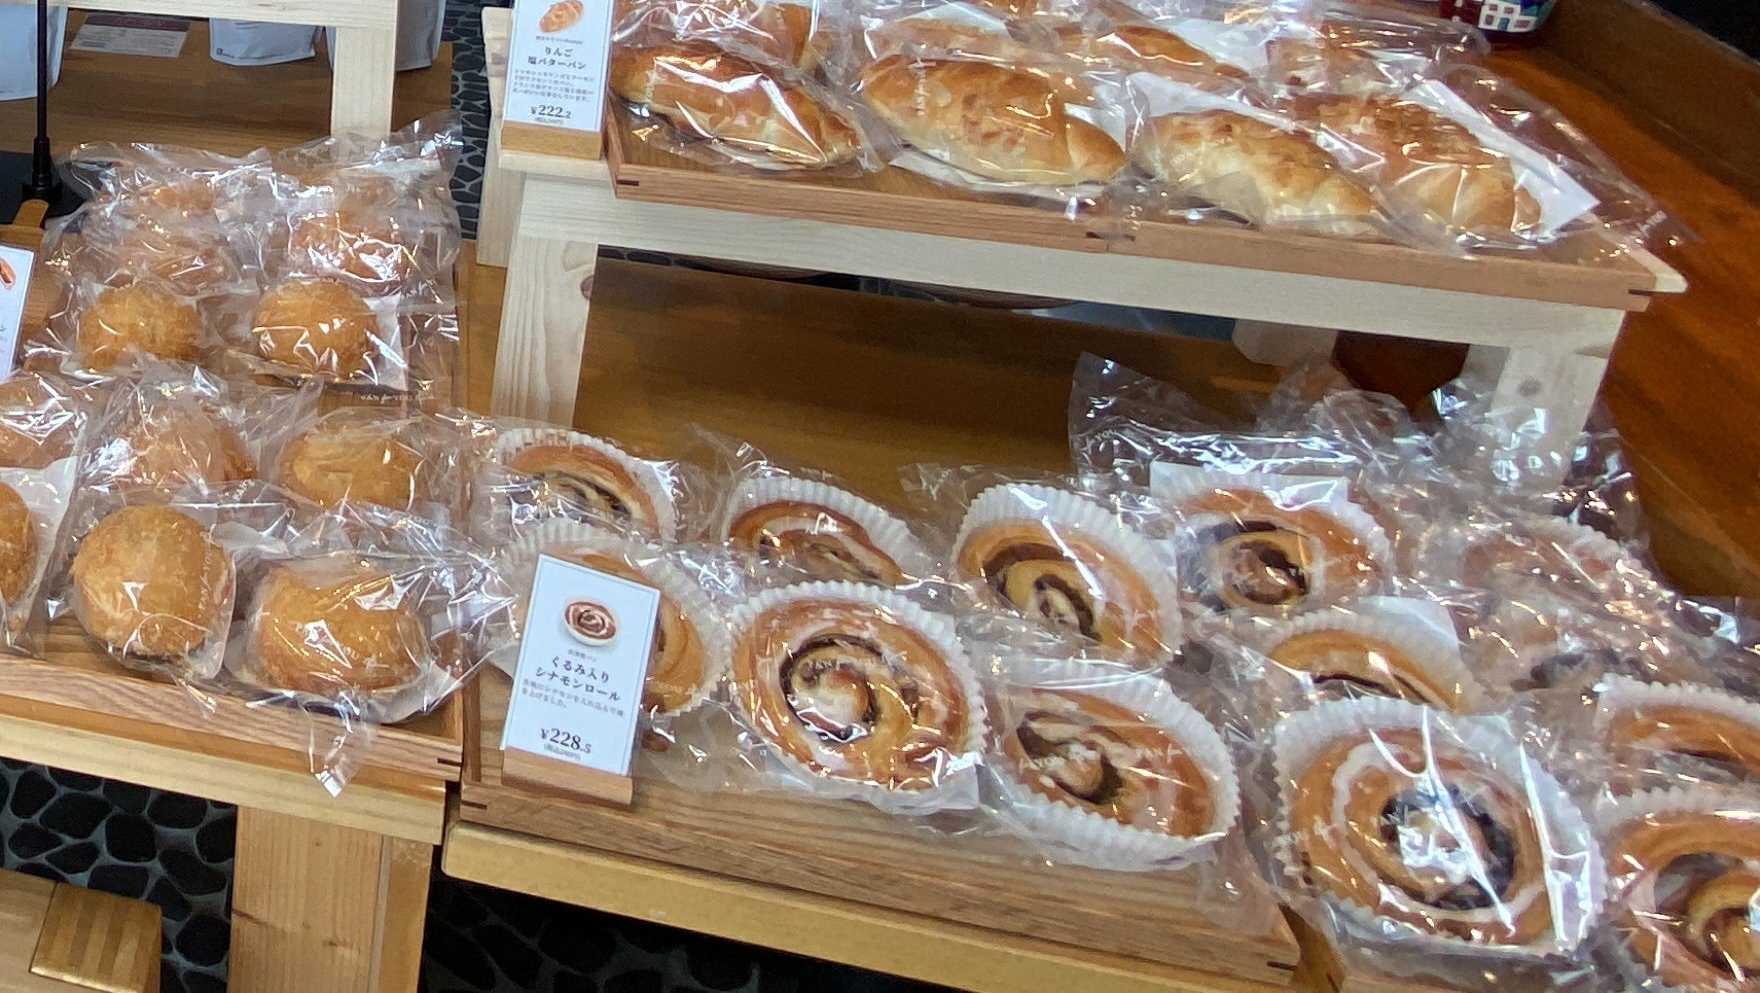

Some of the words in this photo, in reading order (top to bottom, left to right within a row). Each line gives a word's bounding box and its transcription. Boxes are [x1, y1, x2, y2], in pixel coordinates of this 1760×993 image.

[544, 46, 573, 57] りんご
[528, 55, 586, 70] 塩バターパン
[530, 105, 572, 119] ¥222.2
[552, 656, 609, 683] くるみ入り
[535, 667, 620, 701] シナモンロール
[540, 727, 593, 754] ¥228.5
